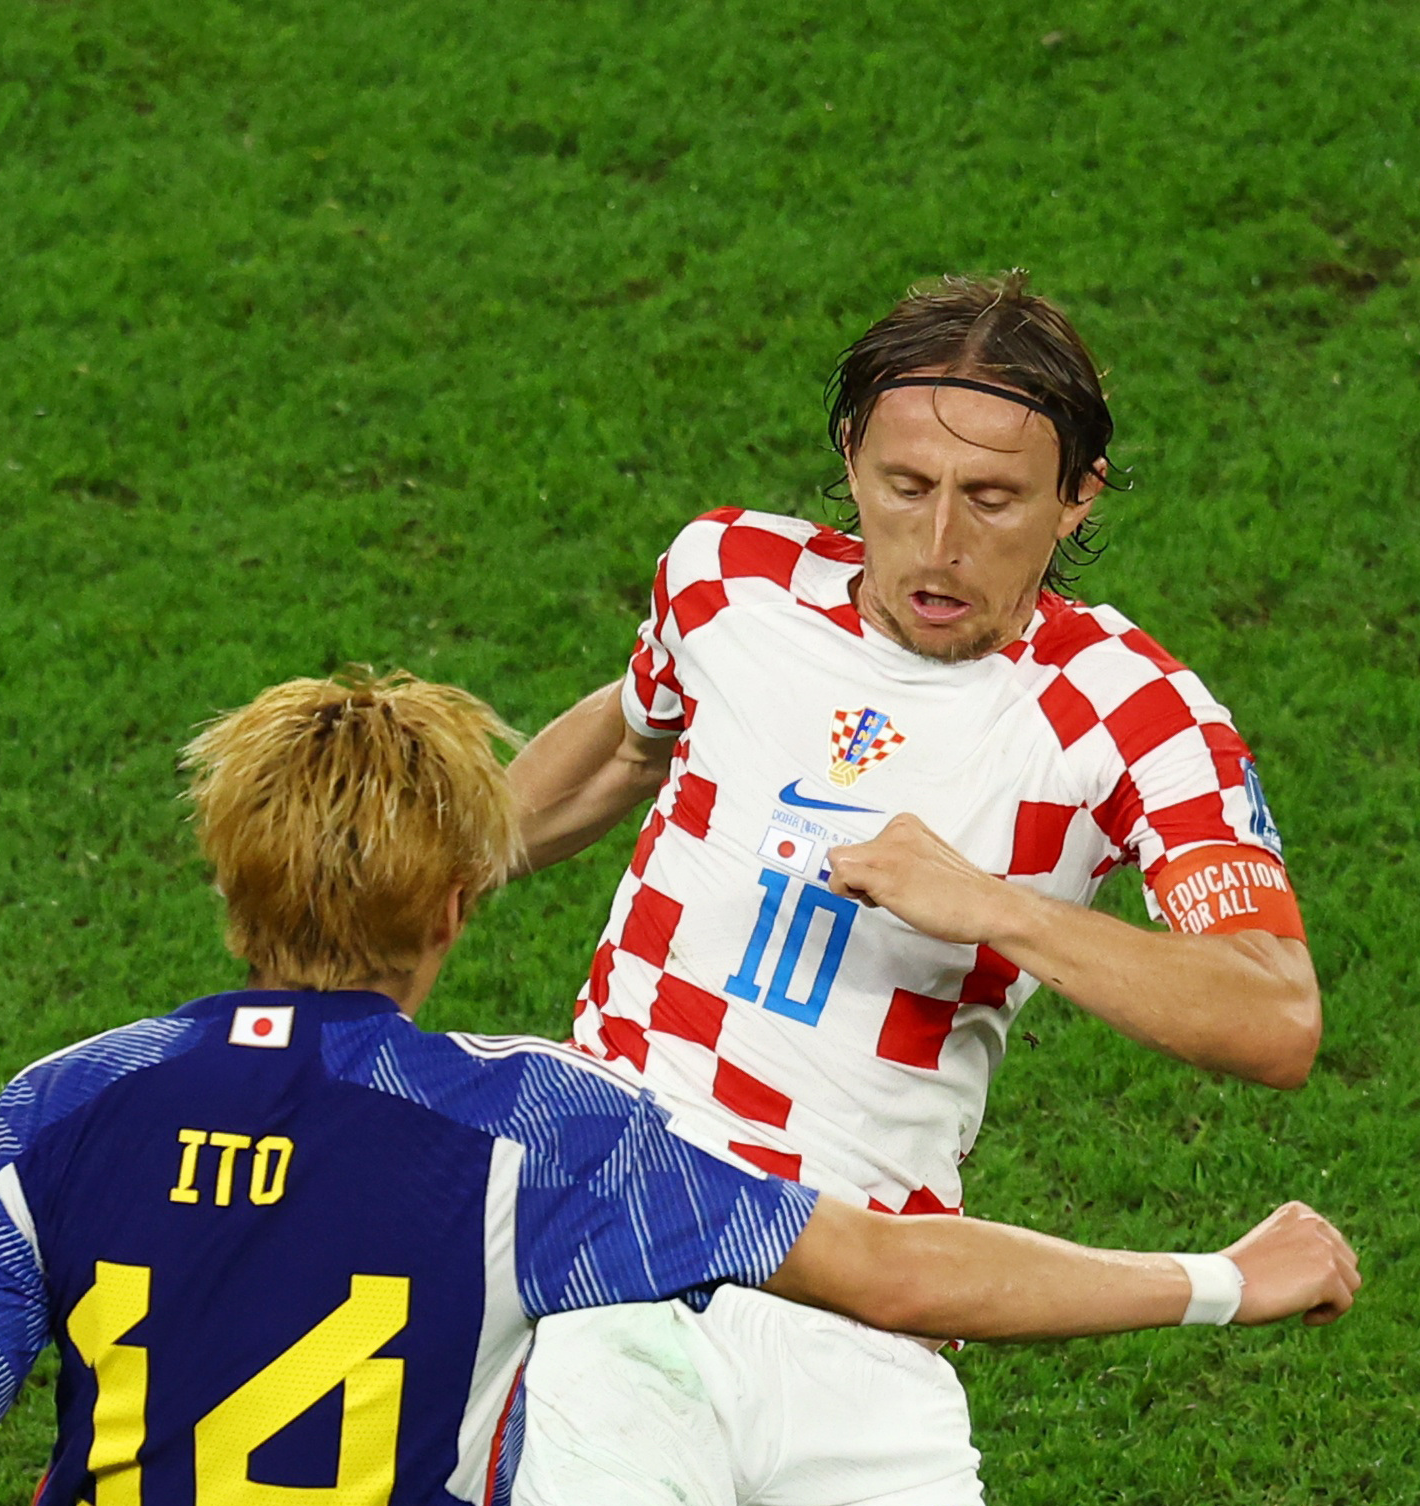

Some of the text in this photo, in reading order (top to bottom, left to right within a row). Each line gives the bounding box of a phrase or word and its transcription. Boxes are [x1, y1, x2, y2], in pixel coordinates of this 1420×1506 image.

[1166, 861, 1288, 921] EDUCATION
[1180, 887, 1259, 935] FOR ALL
[723, 867, 860, 1028] 10
[169, 1128, 295, 1207] ITO
